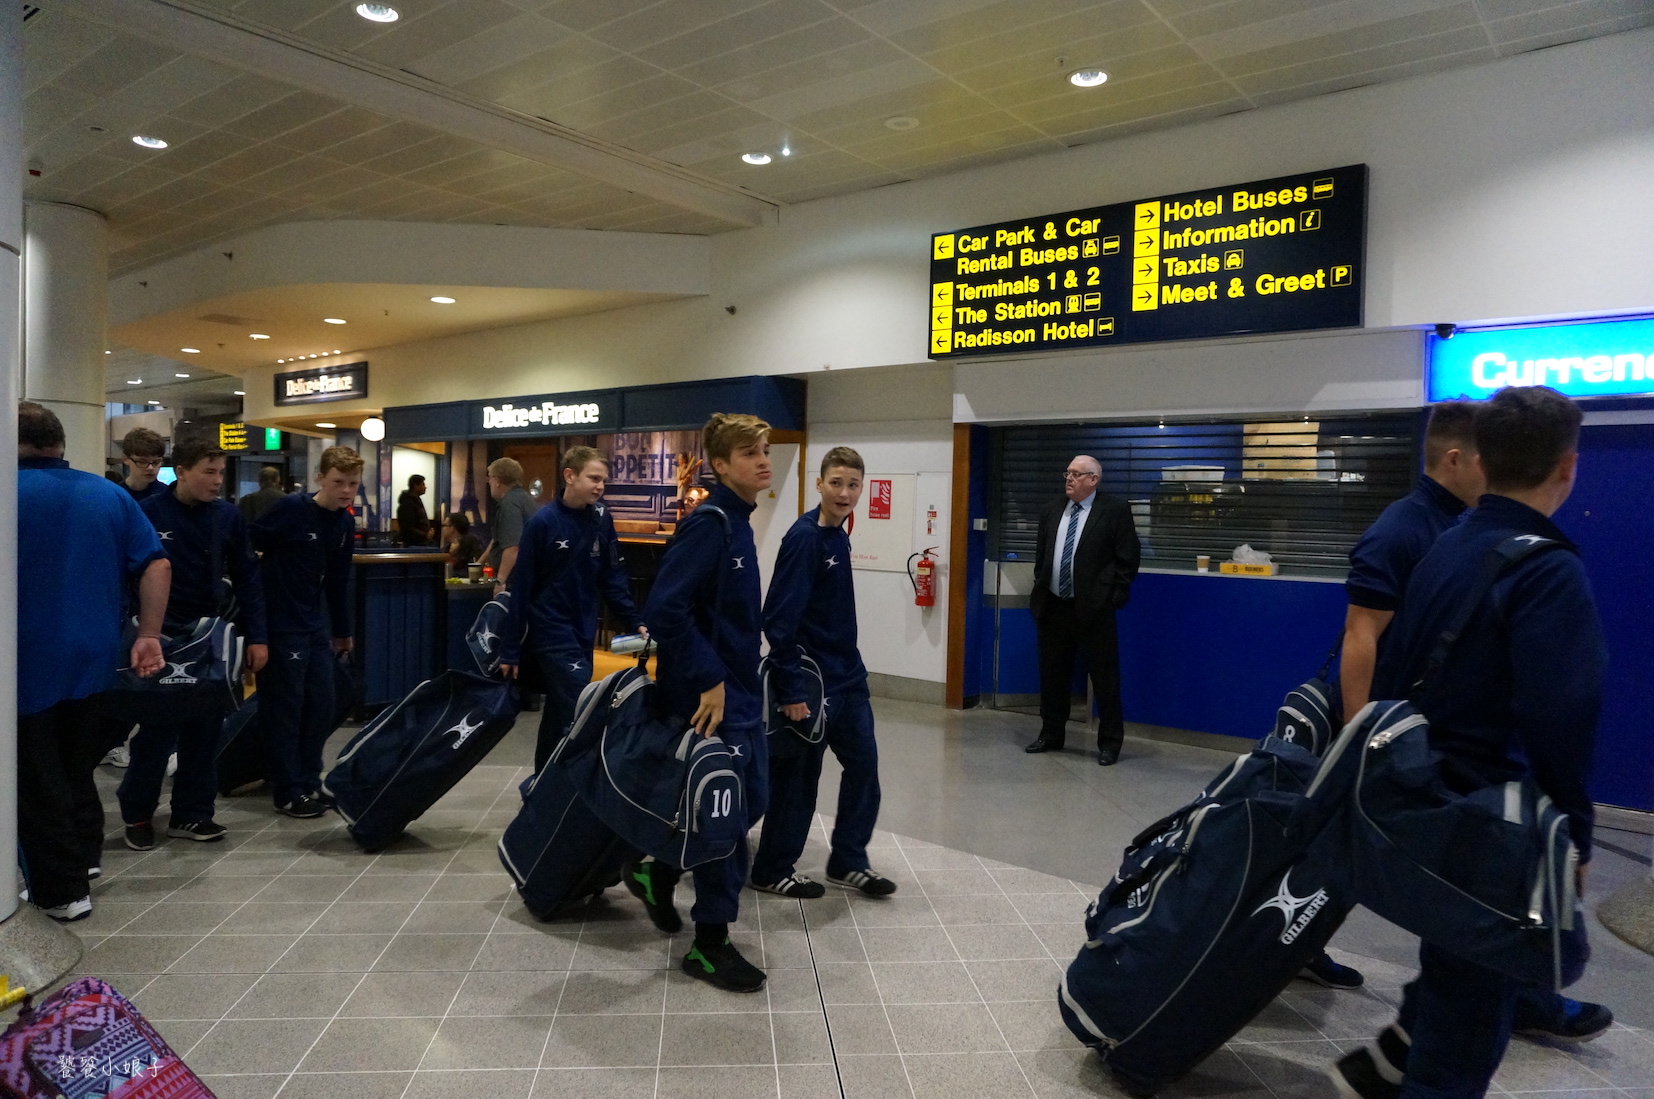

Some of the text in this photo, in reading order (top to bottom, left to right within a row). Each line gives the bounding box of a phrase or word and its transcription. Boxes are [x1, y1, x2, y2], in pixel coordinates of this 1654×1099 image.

[1164, 186, 1307, 222] Hotel Buses
[958, 218, 1101, 253] Car Park & Car
[1163, 216, 1295, 250] Information
[957, 245, 1078, 275] Rental Buses
[1163, 254, 1220, 277] Taxis
[956, 267, 1100, 301] Terminals 1 & 2
[1161, 281, 1217, 305] Meet
[1227, 278, 1245, 298] &
[1255, 269, 1325, 295] Greet
[955, 299, 1061, 325] The Station
[954, 319, 1094, 348] Radisson Hotel
[286, 378, 314, 396] Delice
[319, 375, 353, 392] France
[483, 402, 600, 428] Delice de France
[608, 448, 676, 479] PPÉTIT
[711, 788, 731, 817] 10
[1281, 890, 1329, 945] GILBERT
